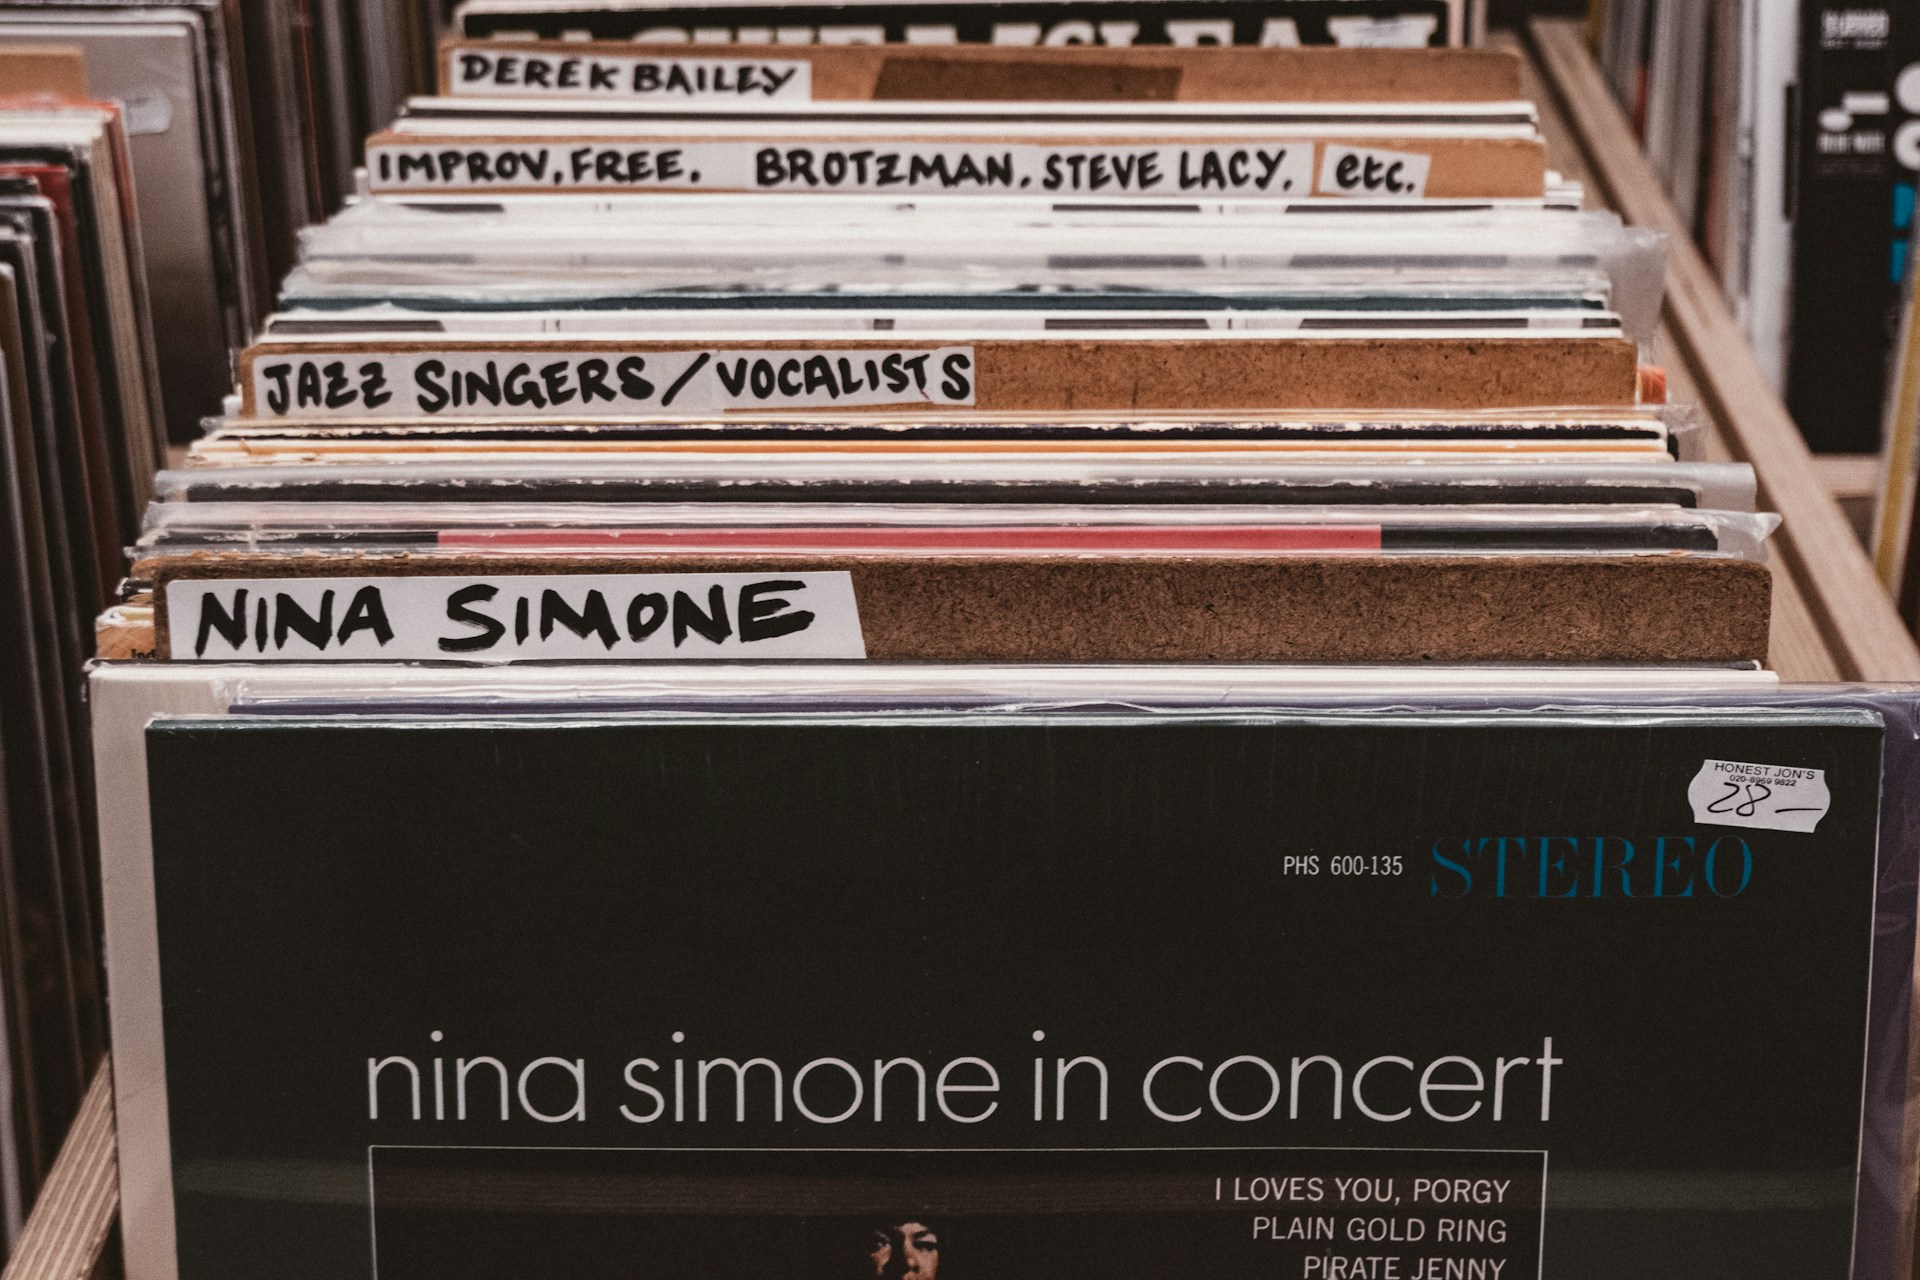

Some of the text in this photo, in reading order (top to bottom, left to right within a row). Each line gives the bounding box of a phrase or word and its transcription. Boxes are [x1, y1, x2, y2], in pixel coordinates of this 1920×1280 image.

[459, 54, 798, 96] DEREK BAILEY
[1043, 152, 1163, 189] STEVE
[1336, 154, 1414, 192] etc.
[263, 362, 392, 416] JAZZ
[195, 580, 815, 658] NINA SIMONE
[1715, 762, 1815, 780] HONEST JON'S
[1284, 856, 1402, 875] PHS 600-135
[1432, 837, 1752, 897] STEREO
[368, 1030, 1563, 1123] nina simone in concert
[1216, 1178, 1510, 1205] I LOVES YOU, PORGY
[1254, 1217, 1506, 1243] PLAIN GOLD RING
[1305, 1256, 1506, 1280] PIRATE JENNY
